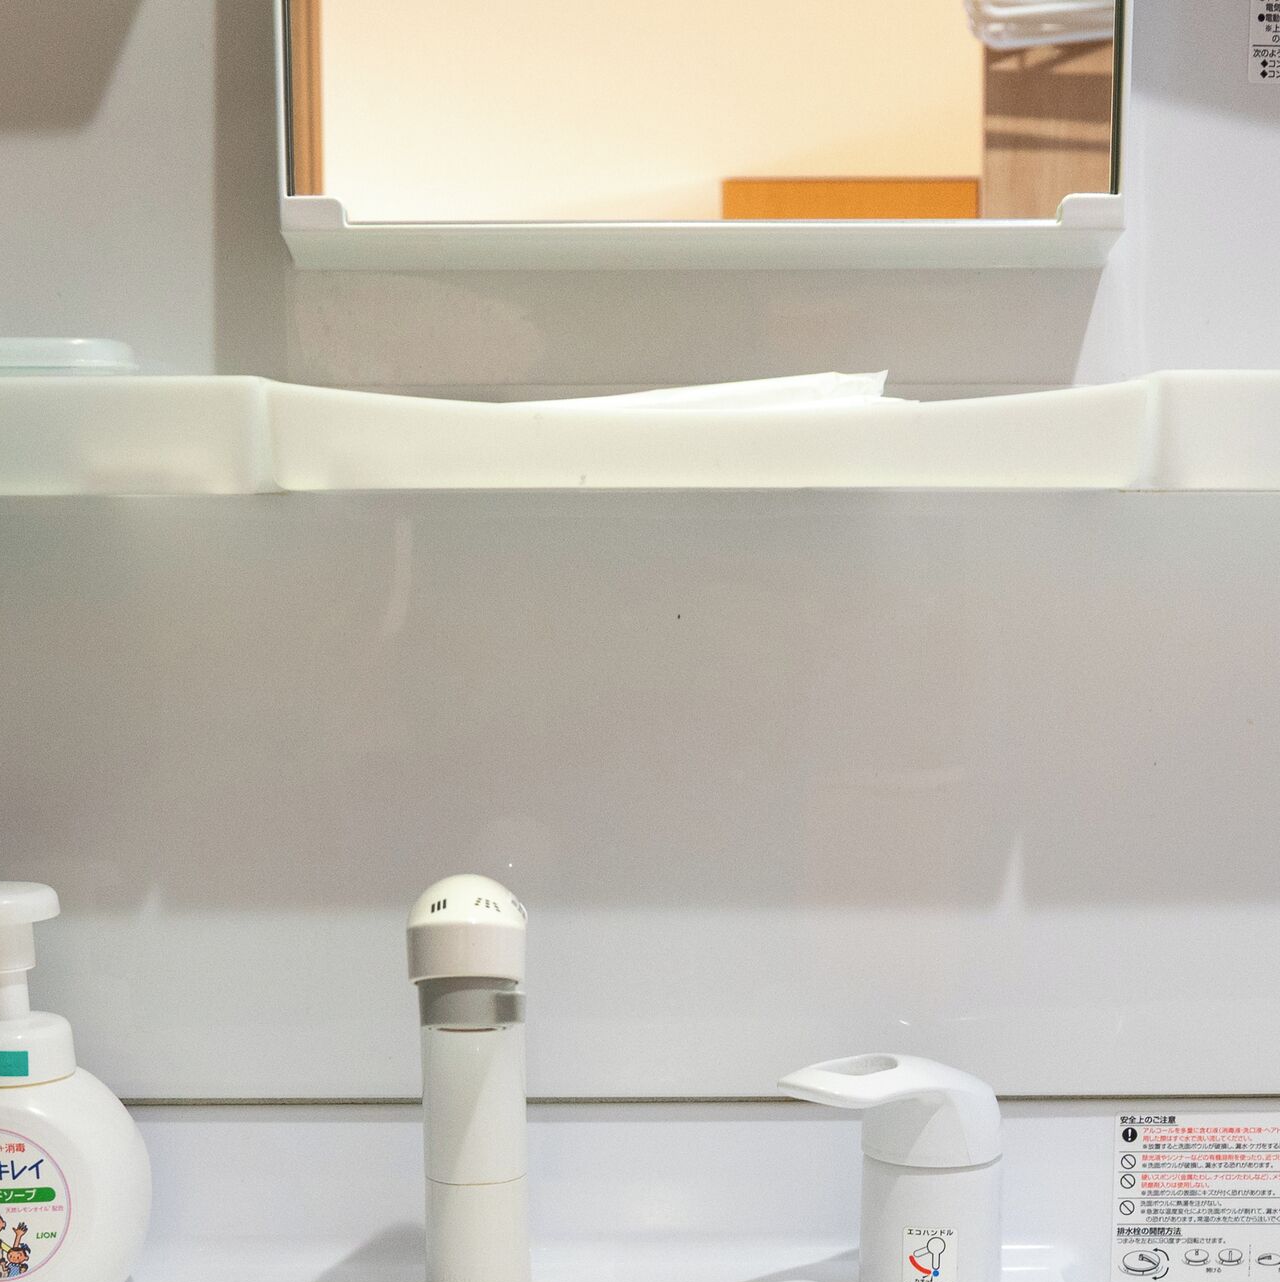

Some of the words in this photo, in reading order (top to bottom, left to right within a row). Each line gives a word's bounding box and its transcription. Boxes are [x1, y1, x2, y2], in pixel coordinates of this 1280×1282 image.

[1120, 1116, 1177, 1124] 安全上のご注意
[36, 1231, 58, 1239] LION
[1117, 1228, 1182, 1236] 排水栓の開閉方法
